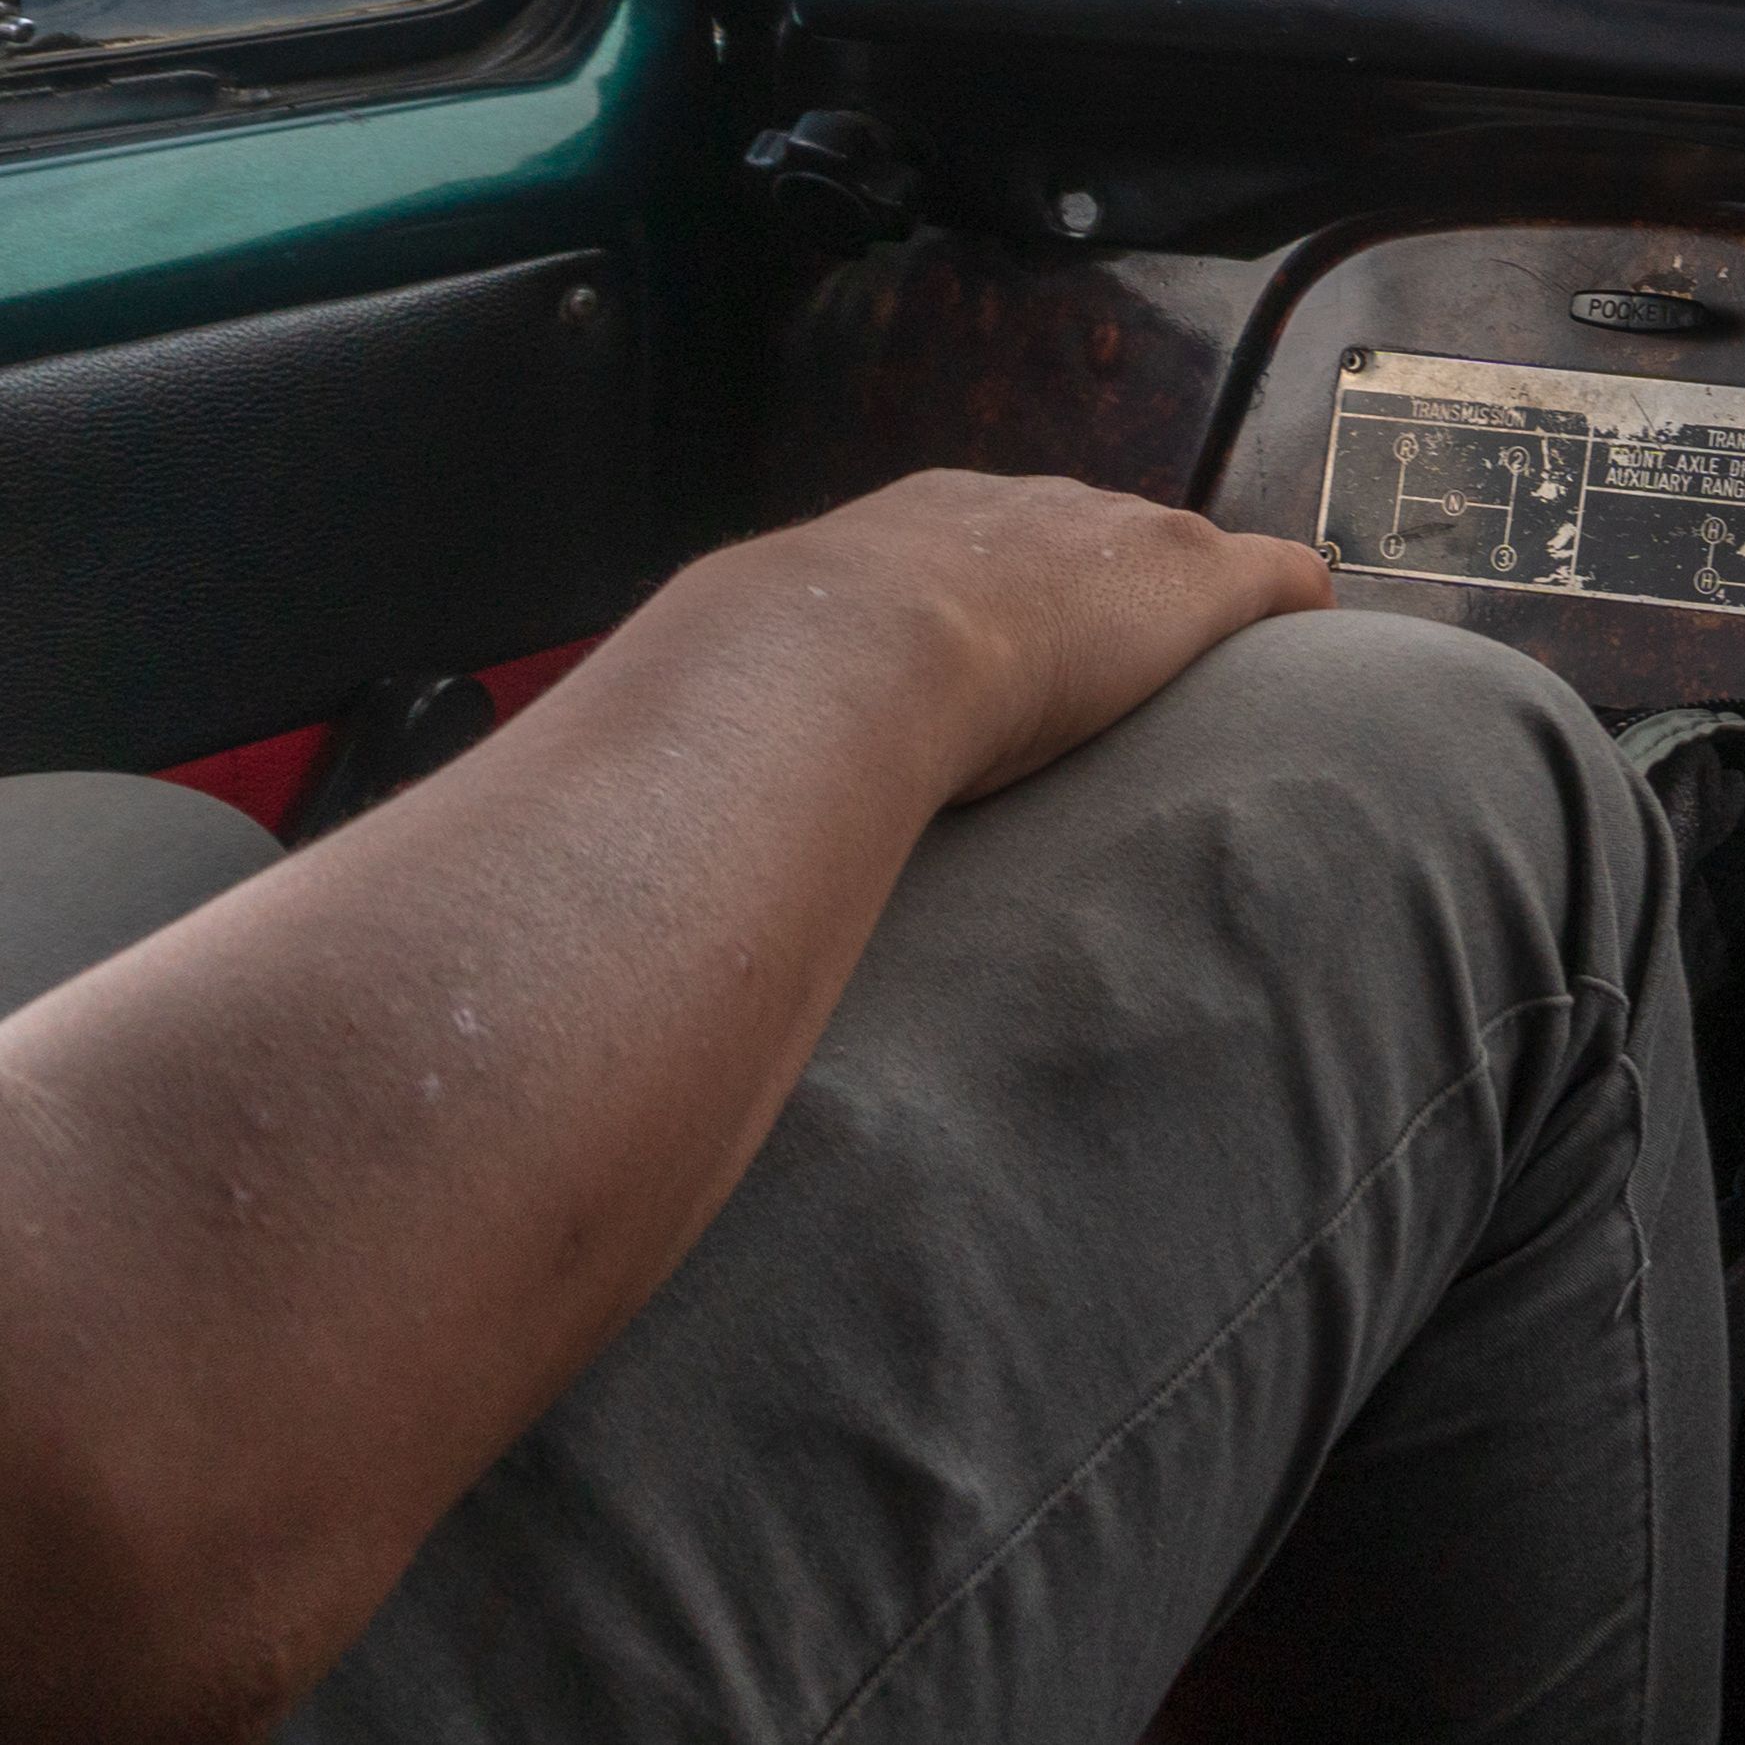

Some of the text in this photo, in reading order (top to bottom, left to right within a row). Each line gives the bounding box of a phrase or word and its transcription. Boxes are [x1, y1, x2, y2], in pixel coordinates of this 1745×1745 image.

[1587, 298, 1673, 324] POCKET
[1411, 398, 1527, 429] TRANSMISSION
[1608, 446, 1666, 470] FRONT
[1675, 455, 1719, 476] AXLE
[1604, 467, 1692, 494] AUXILIARY
